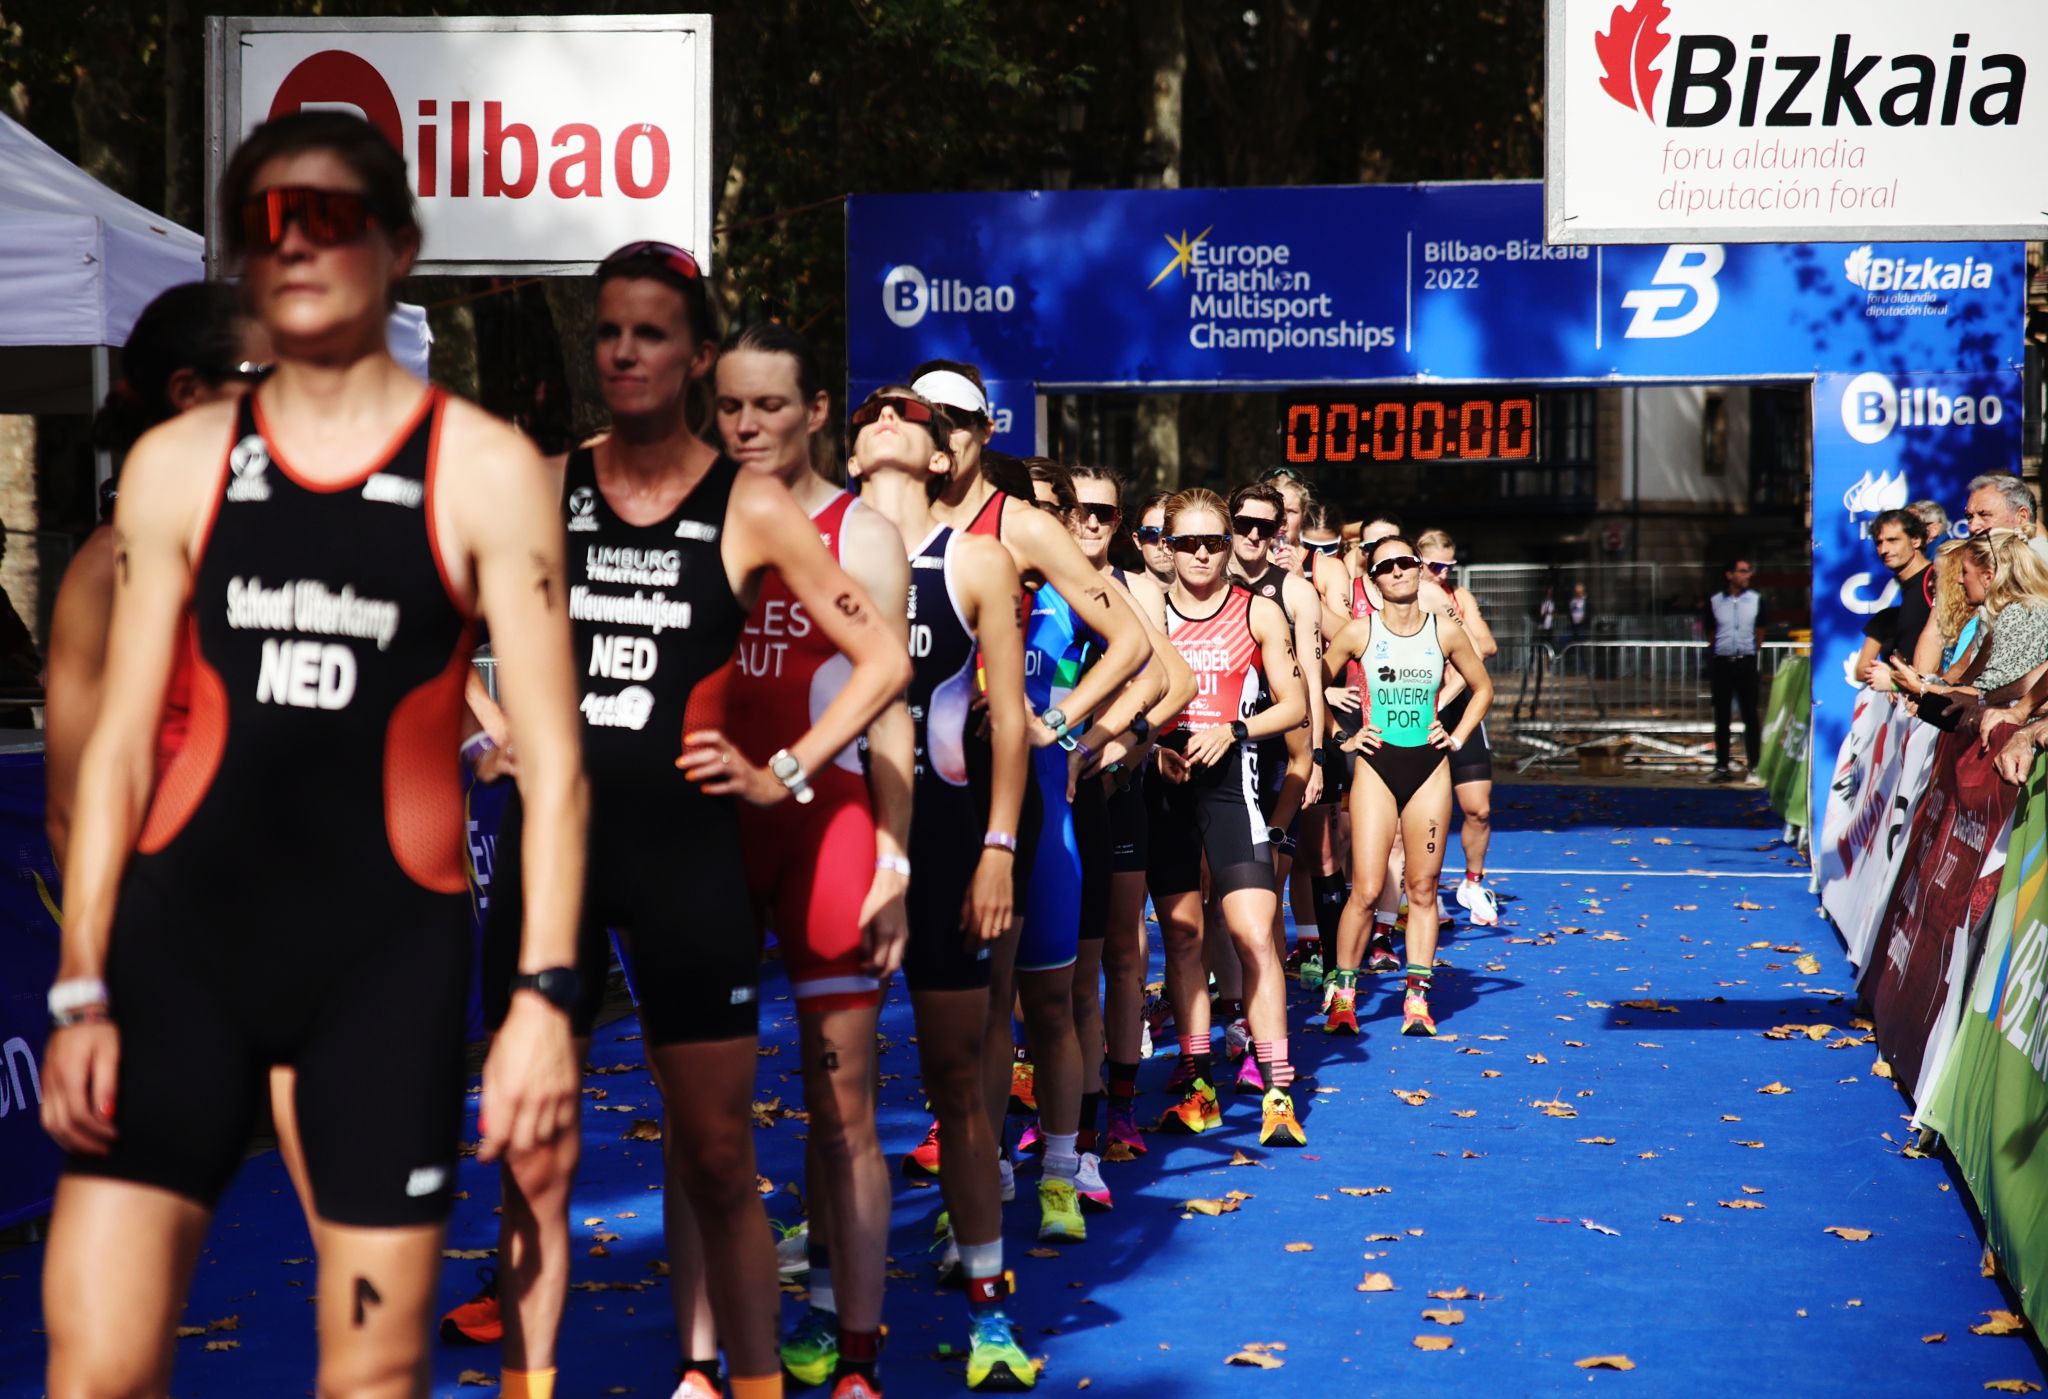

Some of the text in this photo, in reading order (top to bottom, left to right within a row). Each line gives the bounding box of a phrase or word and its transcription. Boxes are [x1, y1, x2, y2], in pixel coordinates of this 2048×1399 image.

[1666, 33, 2027, 128] Bizkaia
[300, 100, 671, 199] ilbao
[1661, 139, 1866, 174] foru aldundia
[1657, 179, 1899, 216] diputación foral
[1191, 241, 1290, 269] Europe
[1190, 267, 1310, 292] Triathlon
[1424, 268, 1480, 289] 2022
[1868, 256, 1994, 292] Bizkaia
[883, 268, 1015, 322] Bilbao
[1190, 292, 1332, 324] Multisport
[1867, 291, 1937, 305] foru aldundia
[1189, 320, 1395, 353] Championships
[1841, 376, 2002, 438] Bilbao
[1286, 400, 1533, 463] 00:00:00
[587, 545, 682, 571] LIMBURG
[744, 601, 812, 637] LES
[588, 633, 658, 681] NED
[256, 637, 358, 711] NED
[1196, 673, 1217, 695] UI
[1399, 668, 1433, 681] JOGOS
[1377, 687, 1430, 706] OLIVEIRA
[1387, 710, 1421, 729] POR
[1427, 827, 1437, 854] 19
